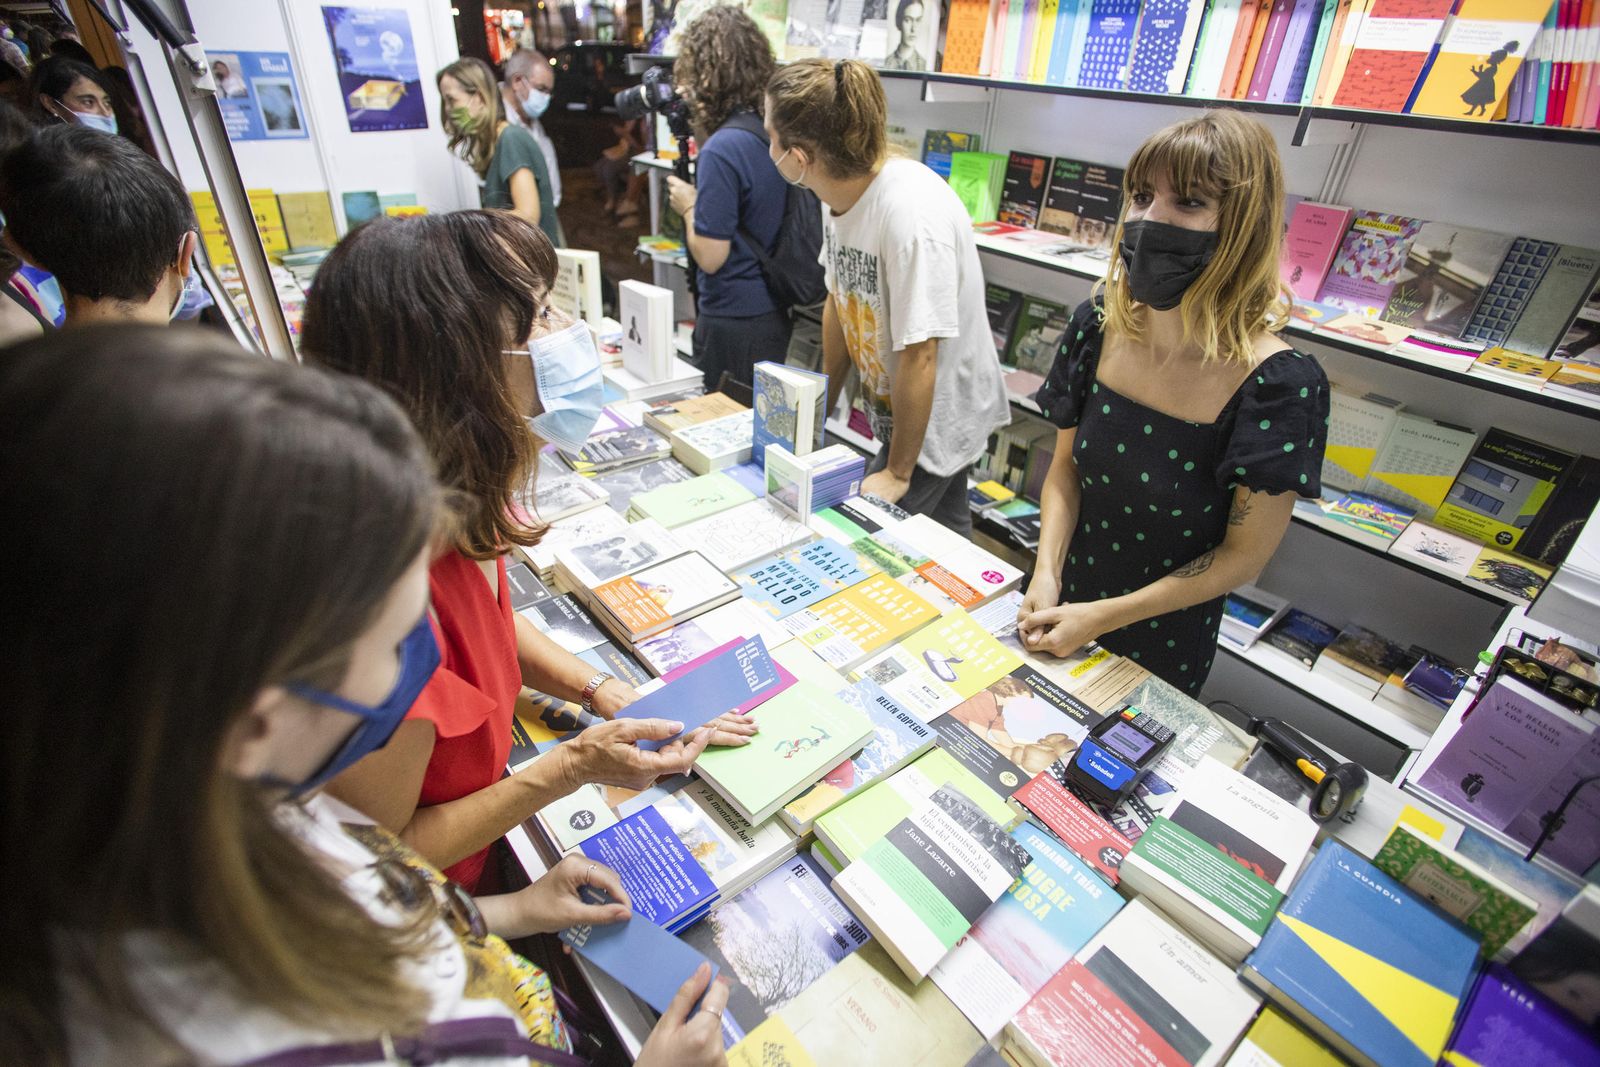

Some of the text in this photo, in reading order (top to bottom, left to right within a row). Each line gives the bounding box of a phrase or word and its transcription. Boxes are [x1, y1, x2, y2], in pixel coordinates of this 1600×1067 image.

[801, 550, 847, 580] ROONEY
[813, 545, 859, 575] SALLY
[750, 570, 797, 605] BELLO
[766, 564, 812, 597] MUNDO
[872, 580, 925, 615] SALLY
[1025, 677, 1085, 720] Los nombres propios
[1030, 673, 1045, 686] MARTA
[1065, 696, 1090, 716] SERRANO
[897, 711, 929, 738] GOPEGUI
[1184, 725, 1224, 760] INVIERNO
[1042, 775, 1061, 792] PREMIO
[1090, 760, 1115, 780] Sabadell
[1226, 784, 1240, 796] La
[711, 801, 740, 831] montaña
[737, 829, 756, 849] baila
[1034, 782, 1046, 793] UNO
[1061, 802, 1081, 822] LIBROS
[1089, 827, 1104, 840] AÑO
[904, 826, 957, 878] Jane Lazarre
[919, 814, 989, 883] hija del comunista
[938, 817, 978, 856] comunista
[1073, 870, 1103, 899] TRÍAS
[1338, 860, 1351, 872] LA
[1353, 870, 1402, 905] GUARDIA
[1160, 942, 1209, 985] Un amor
[1071, 979, 1099, 1007] MEJOR
[1097, 1003, 1122, 1031] LIBRO
[1121, 1027, 1138, 1047] DEL
[1501, 982, 1535, 1012] VERA
[847, 996, 877, 1034] VERANO
